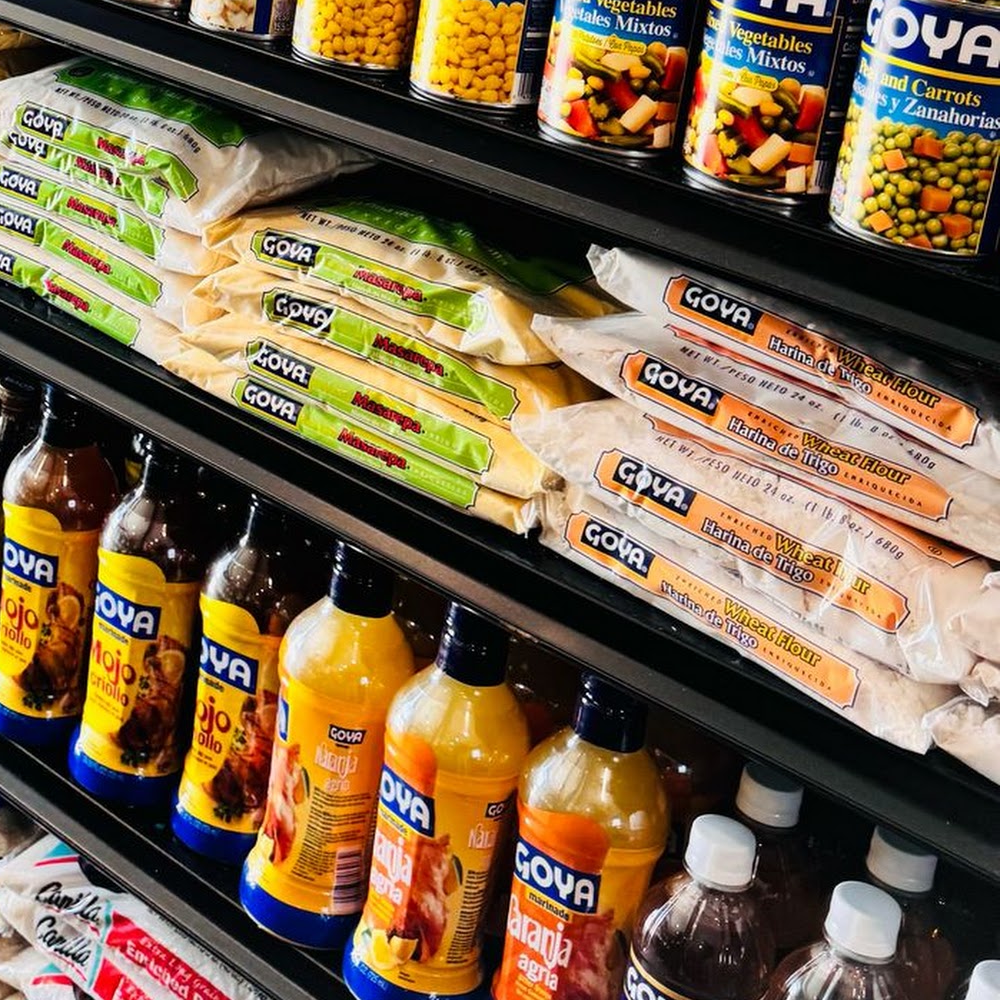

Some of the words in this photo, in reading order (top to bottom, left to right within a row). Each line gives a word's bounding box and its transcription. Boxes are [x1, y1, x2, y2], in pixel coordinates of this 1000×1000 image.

[615, 15, 671, 38] Mixtos
[727, 22, 813, 55] Vegetables
[746, 47, 806, 74] Mixtos
[881, 74, 907, 92] and
[911, 78, 981, 108] Carrots
[23, 111, 64, 138] GOYA
[888, 98, 898, 116] y
[902, 100, 1000, 131] Zanahorias
[0, 171, 37, 197] GOYA
[262, 235, 312, 263] GOYA
[684, 286, 750, 328] GOYA
[255, 346, 307, 385] GOYA
[768, 336, 815, 366] Harina
[817, 358, 836, 376] de
[243, 382, 298, 422] GOYA
[644, 362, 710, 408] GOYA
[890, 375, 942, 409] Flour
[654, 434, 677, 448] NET
[763, 481, 779, 495] 24
[728, 417, 776, 449] Harina
[779, 443, 799, 459] de
[801, 449, 839, 476] Trigo
[801, 433, 859, 466] Wheat
[860, 457, 911, 486] Flour
[618, 463, 683, 509] GOYA
[3, 541, 54, 583] OYA
[584, 523, 644, 571] GOYA
[701, 519, 751, 552] Harina
[752, 545, 773, 563] de
[775, 552, 814, 583] Trigo
[775, 532, 835, 571] Wheat
[660, 581, 704, 617] Harina
[706, 609, 722, 629] de
[725, 617, 758, 649] Trigo
[724, 600, 775, 641] Wheat
[776, 627, 821, 667] Flour
[329, 728, 363, 743] GOYA
[380, 776, 431, 830] OYA
[515, 841, 595, 908] GOYA
[528, 889, 570, 921] marinade
[517, 954, 558, 990] agria
